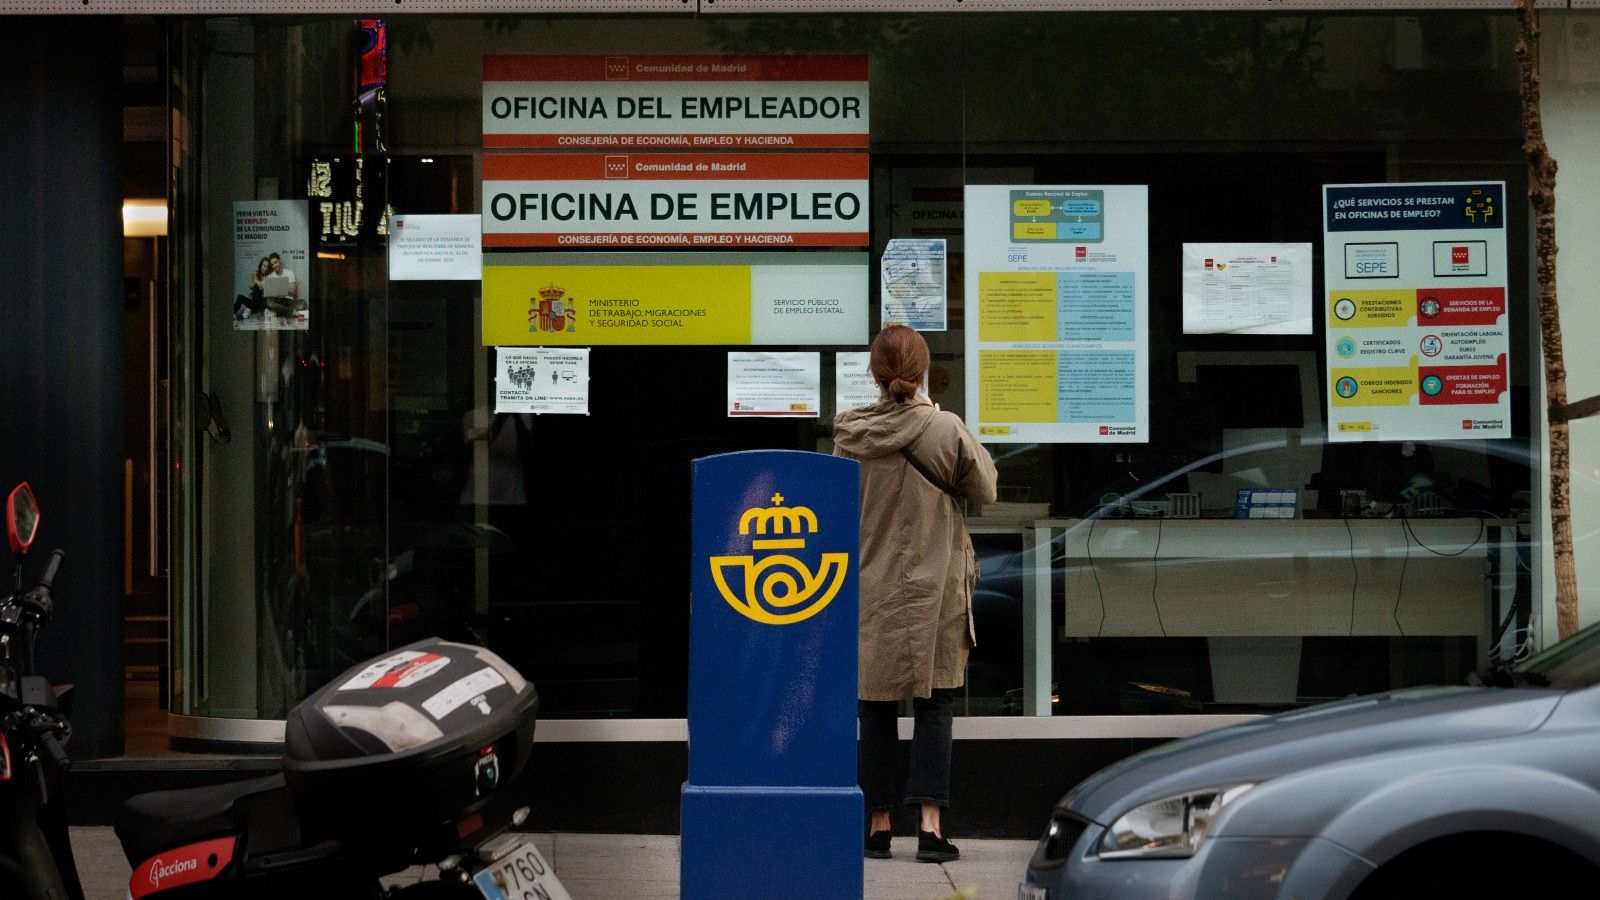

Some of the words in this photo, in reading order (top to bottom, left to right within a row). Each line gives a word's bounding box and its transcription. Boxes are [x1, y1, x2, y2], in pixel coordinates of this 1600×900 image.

[636, 63, 693, 74] Comunidad
[696, 63, 709, 74] de
[712, 63, 747, 74] Madrid
[491, 97, 608, 119] OFICINA
[617, 97, 672, 119] DEL
[681, 97, 861, 119] EMPLEADOR
[558, 136, 614, 146] CONSEJERÍA
[617, 137, 634, 145] DE
[636, 136, 692, 147] ECONOMÍA,
[694, 137, 732, 145] EMPLEO
[735, 137, 742, 145] Y
[744, 137, 794, 145] HACIENDA
[635, 162, 693, 172] Comunidad
[696, 162, 708, 172] de
[712, 162, 747, 172] Madrid
[491, 193, 639, 221] OFICINA
[651, 193, 698, 221] DE
[710, 193, 861, 221] EMPLEO
[1333, 198, 1356, 209] ¿QUÉ
[1358, 198, 1403, 207] SERVICIOS
[1404, 198, 1415, 206] SE
[1416, 197, 1455, 205] PRESTAN
[1335, 212, 1347, 220] EN
[1348, 211, 1388, 219] OFICINAS
[1390, 210, 1401, 218] DE
[1403, 210, 1441, 218] EMPLEO?
[558, 234, 614, 244] CONSEJERÍA
[617, 235, 634, 244] DE
[636, 234, 692, 245] ECONOMÍA,
[694, 235, 732, 244] EMPLEO
[735, 235, 742, 244] Y
[744, 235, 794, 244] HACIENDA
[1356, 262, 1387, 274] SEPE
[589, 299, 640, 308] MINISTERIO
[773, 299, 807, 307] SERVICIO
[808, 297, 839, 307] PÚBLICO
[589, 309, 600, 317] DE
[645, 309, 707, 317] MIGRACIONES
[773, 307, 782, 315] DE
[784, 307, 814, 315] EMPLEO
[815, 307, 844, 315] ESTATAL
[596, 319, 649, 328] SEGURIDAD
[652, 319, 684, 328] SOCIAL
[160, 858, 197, 878] acciona
